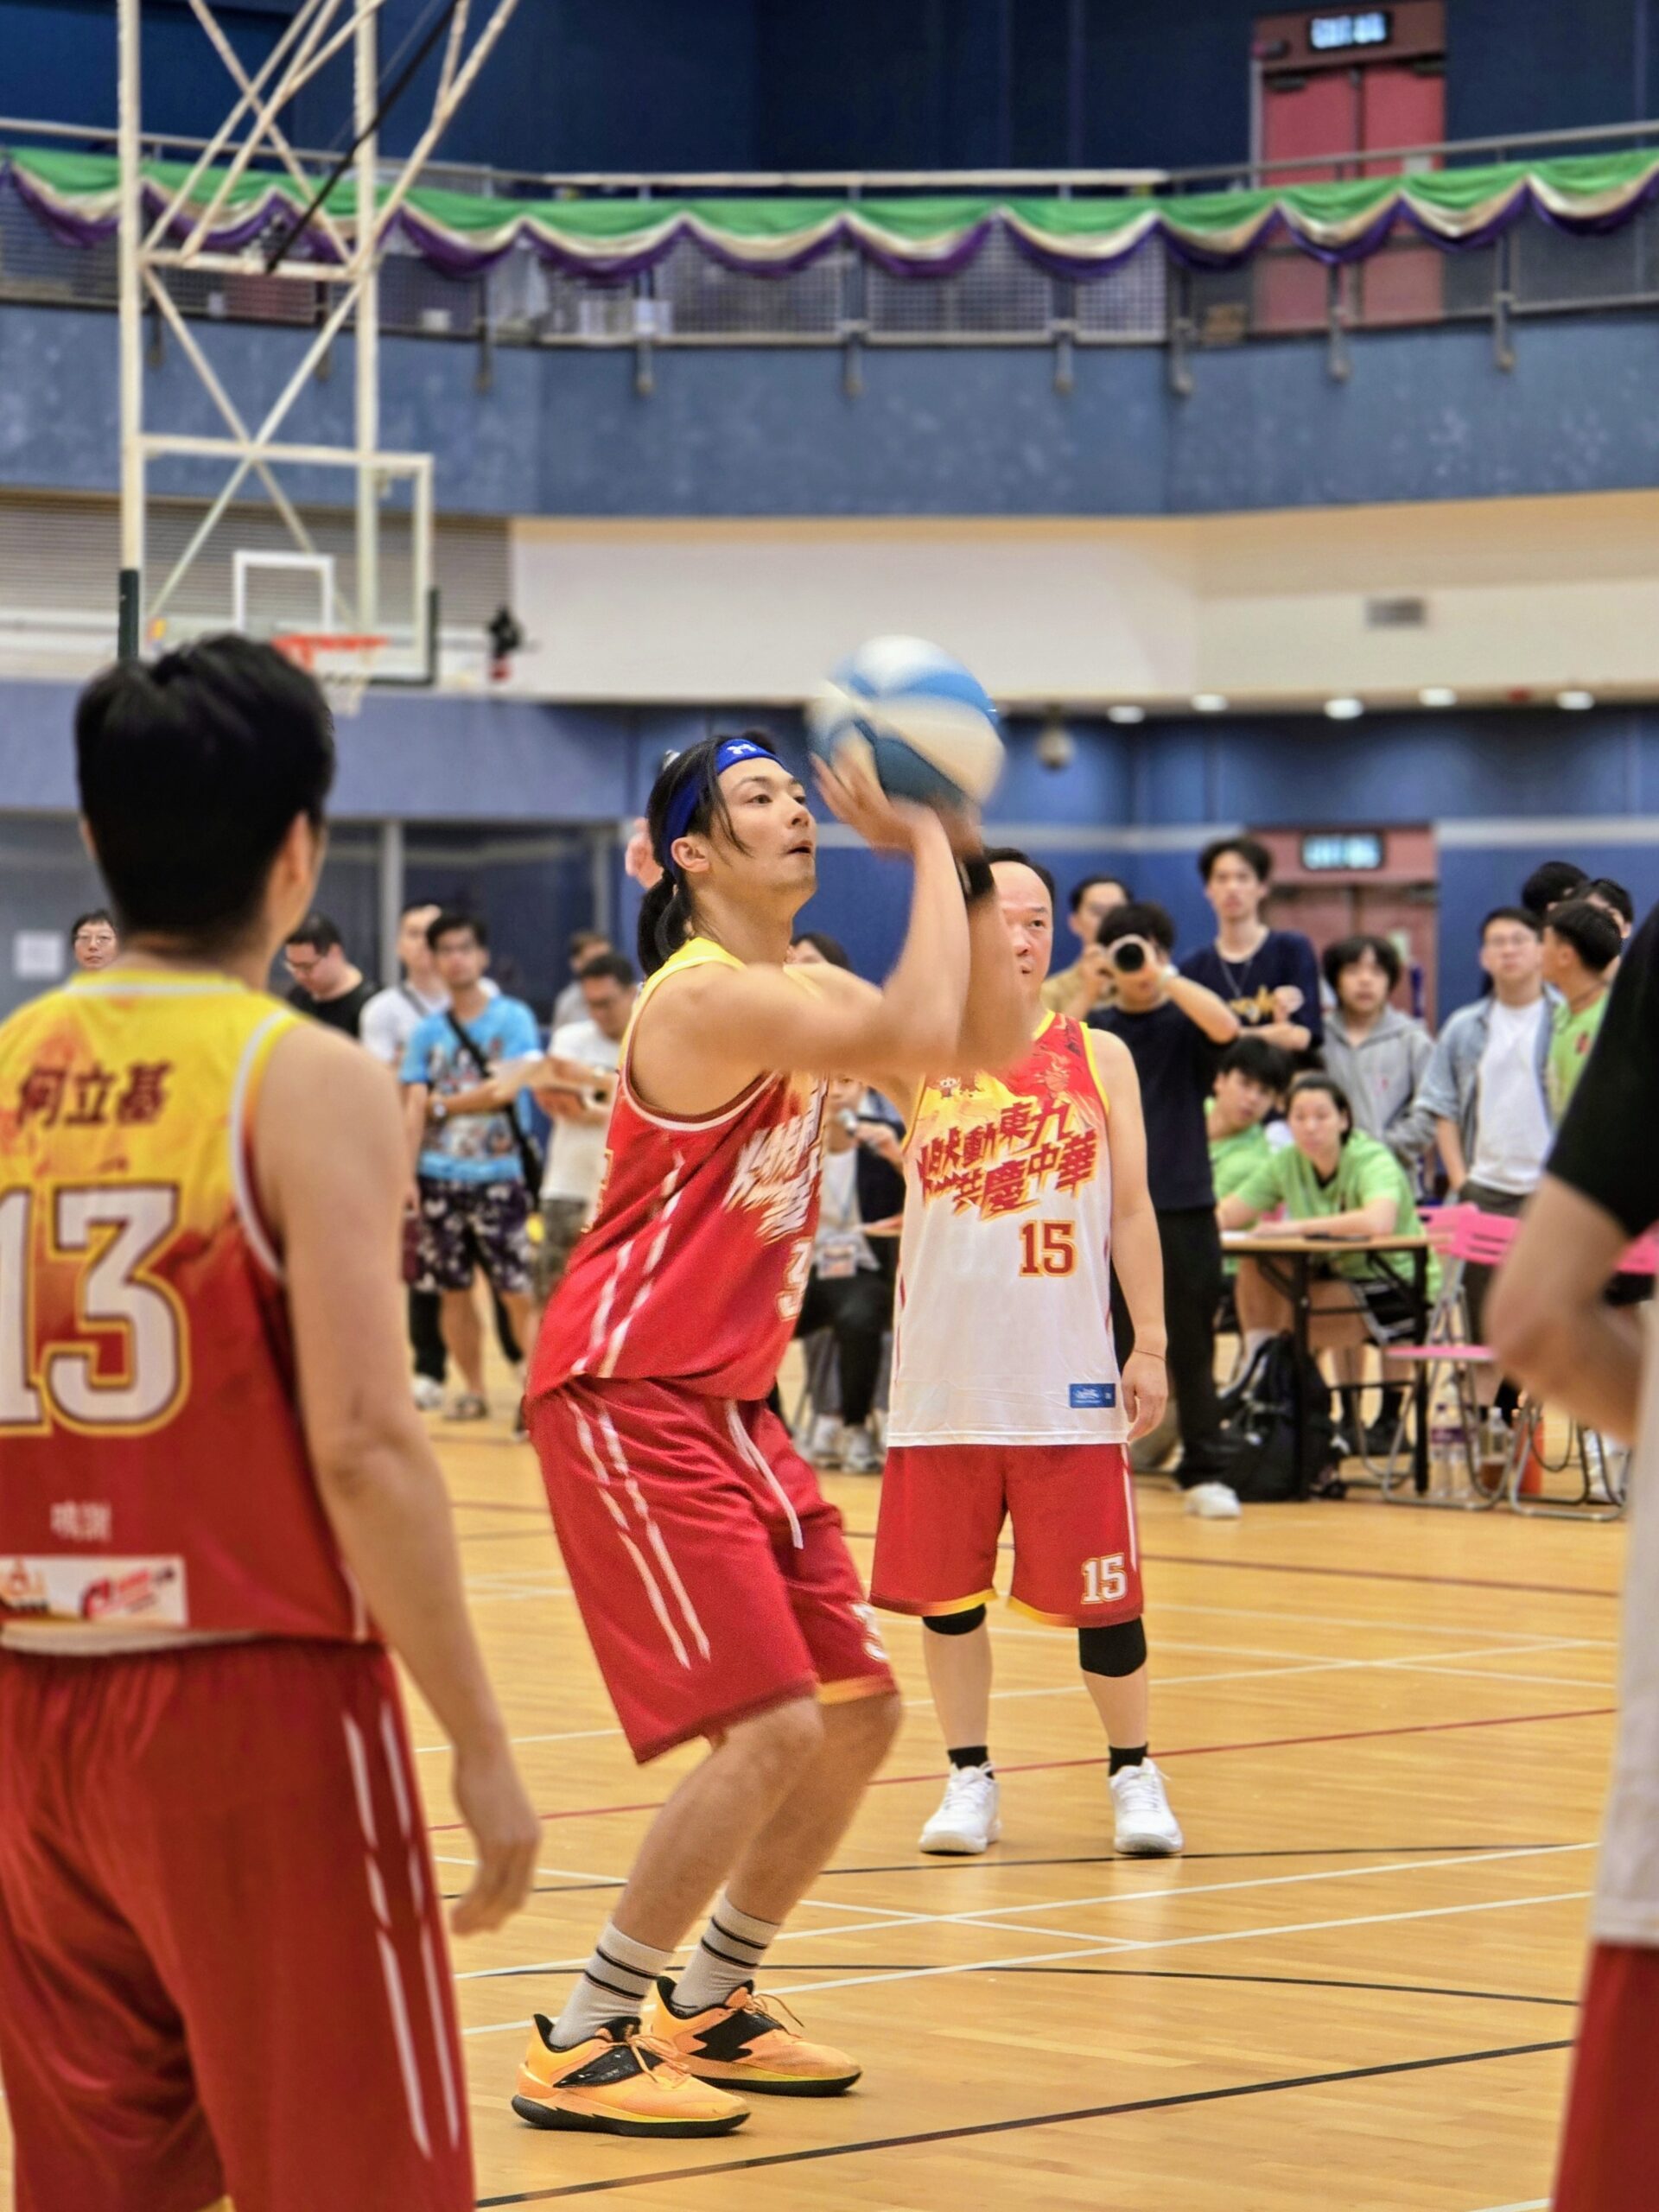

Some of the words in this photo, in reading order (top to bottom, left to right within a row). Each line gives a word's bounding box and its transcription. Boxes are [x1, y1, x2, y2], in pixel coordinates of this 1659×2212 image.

[1018, 1219, 1077, 1277] 15
[0, 1181, 189, 1435] 13
[1081, 1553, 1127, 1605] 15
